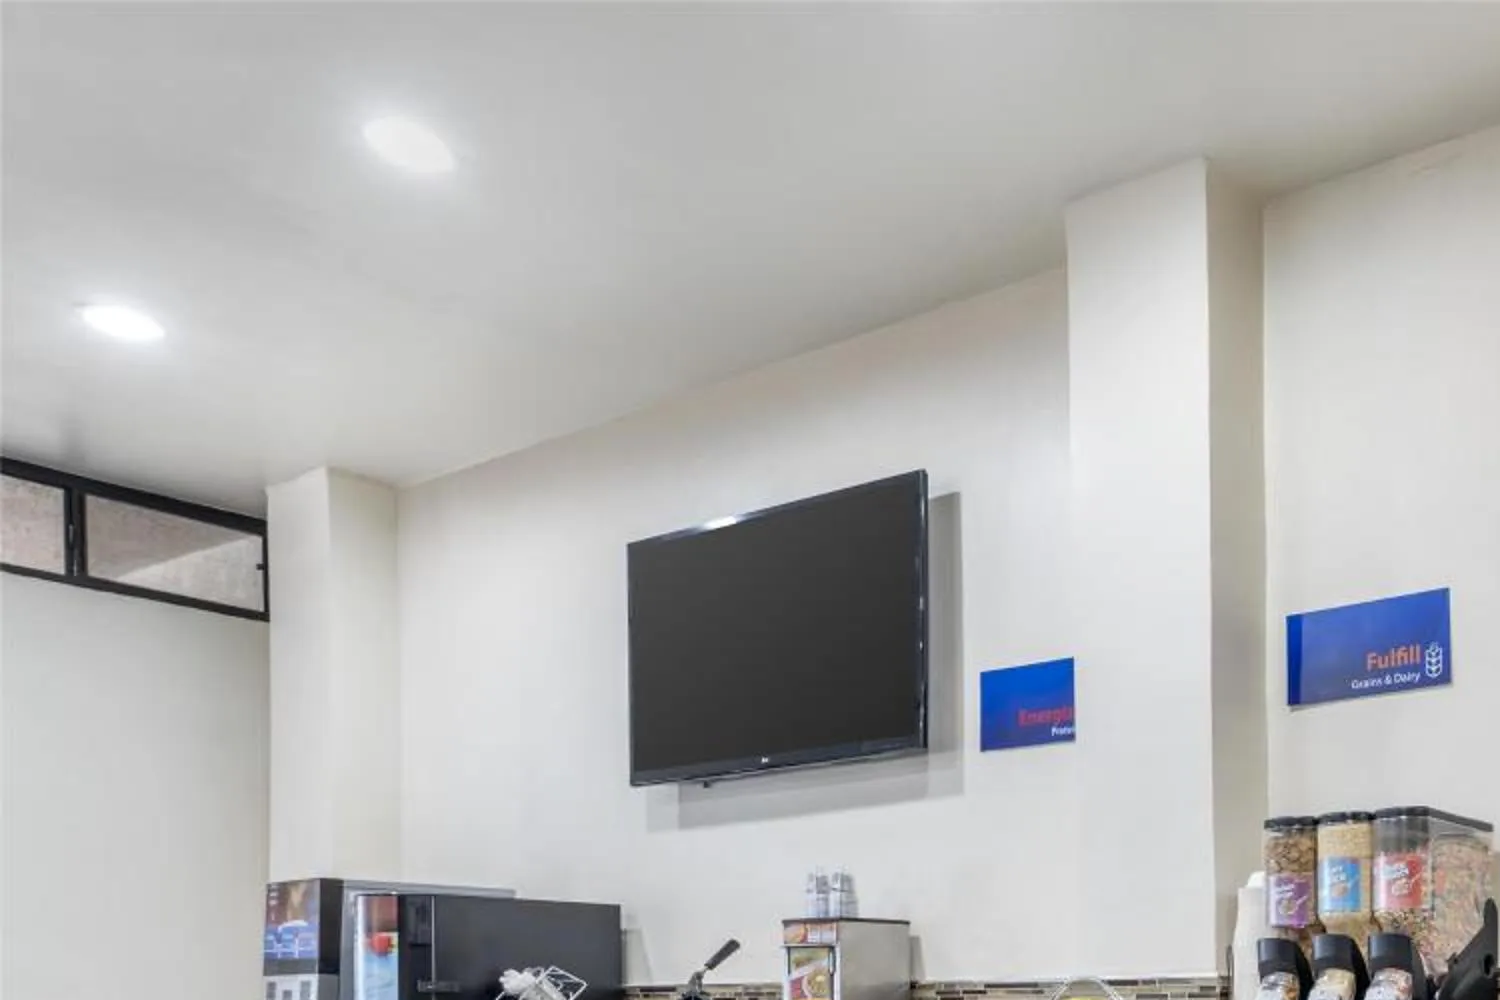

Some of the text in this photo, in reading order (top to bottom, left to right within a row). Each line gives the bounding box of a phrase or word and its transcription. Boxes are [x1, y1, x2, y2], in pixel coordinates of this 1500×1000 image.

[1366, 643, 1421, 672] Fulfill
[1351, 671, 1421, 690] Grains & Dairy
